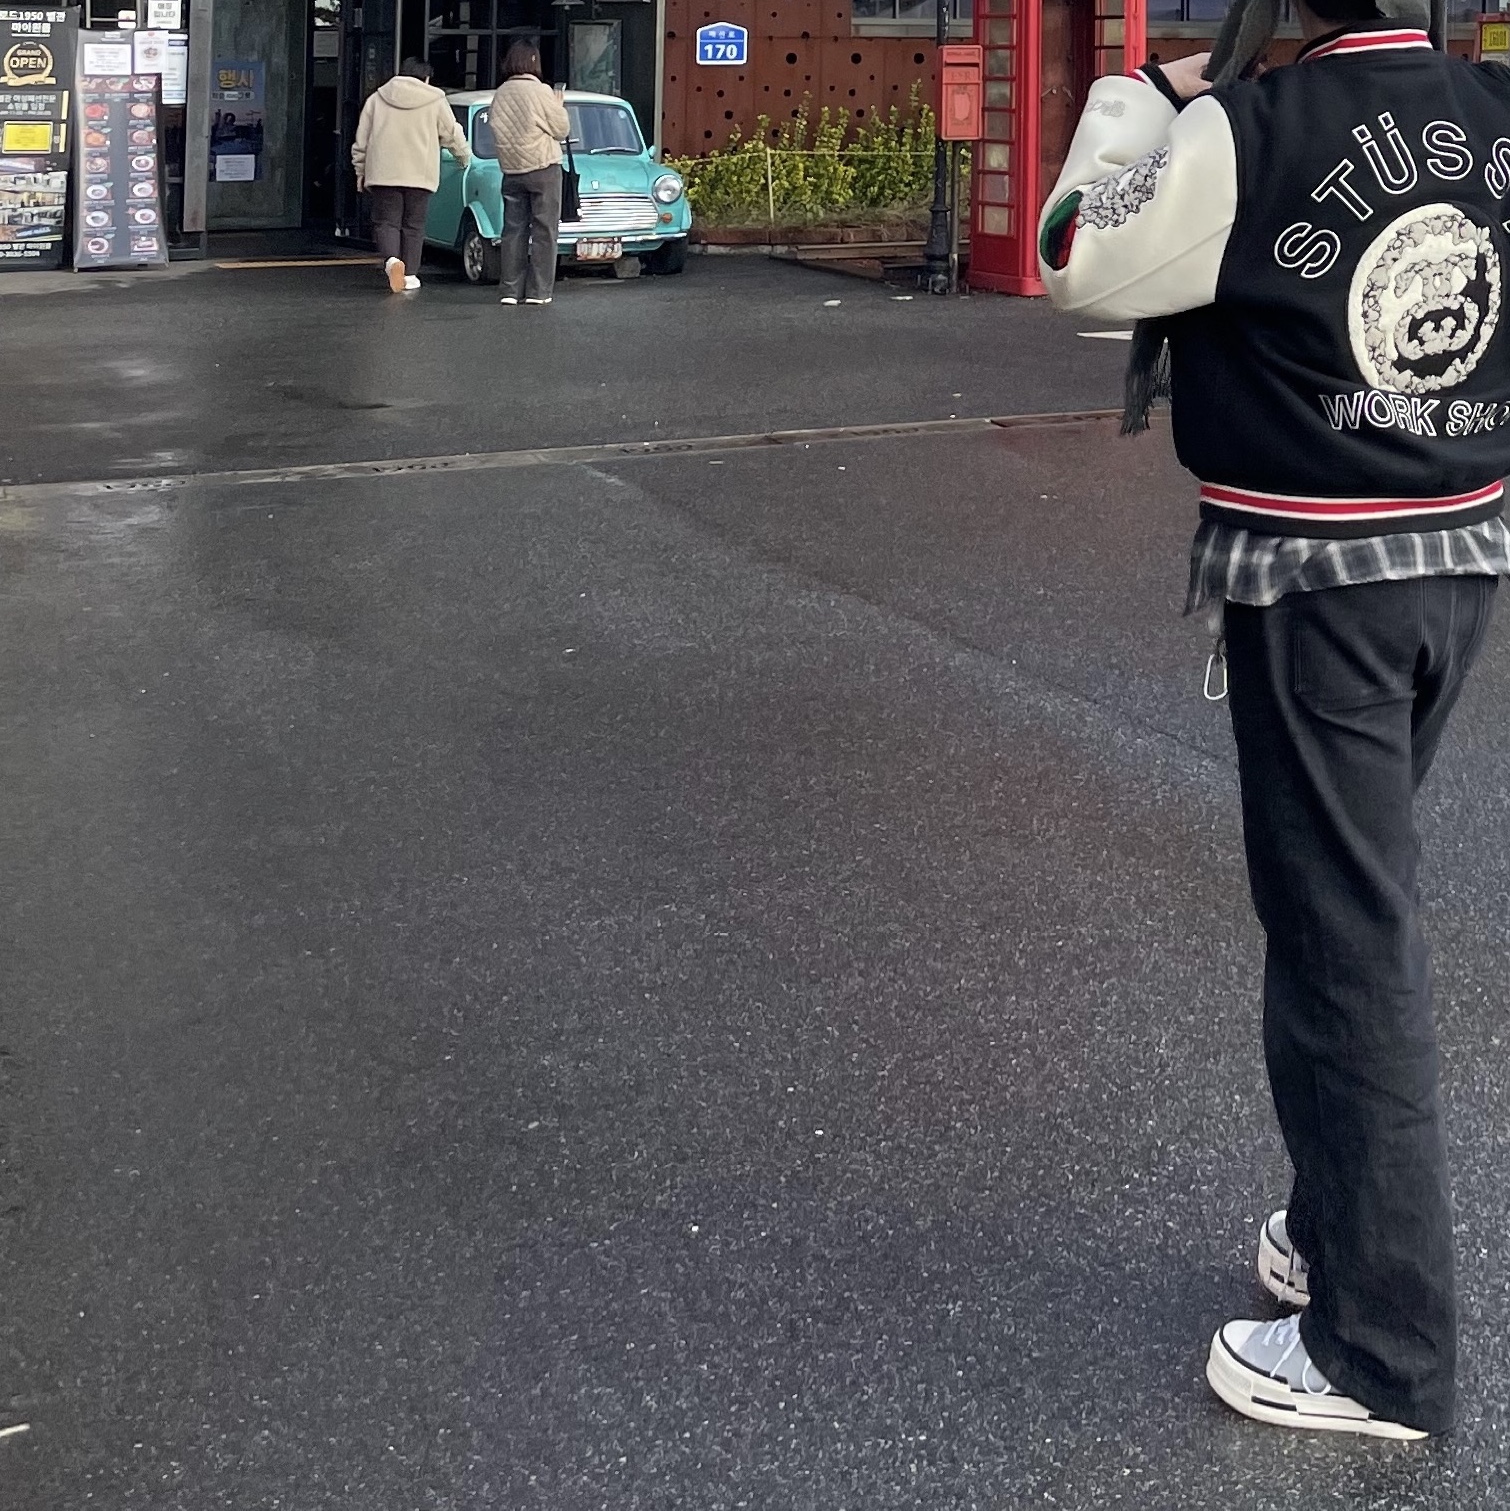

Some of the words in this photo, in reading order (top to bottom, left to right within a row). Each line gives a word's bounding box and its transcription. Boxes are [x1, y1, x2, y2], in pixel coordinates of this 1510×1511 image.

[704, 44, 738, 60] 170
[9, 56, 47, 69] OPEN
[1318, 388, 1440, 437] WORK
